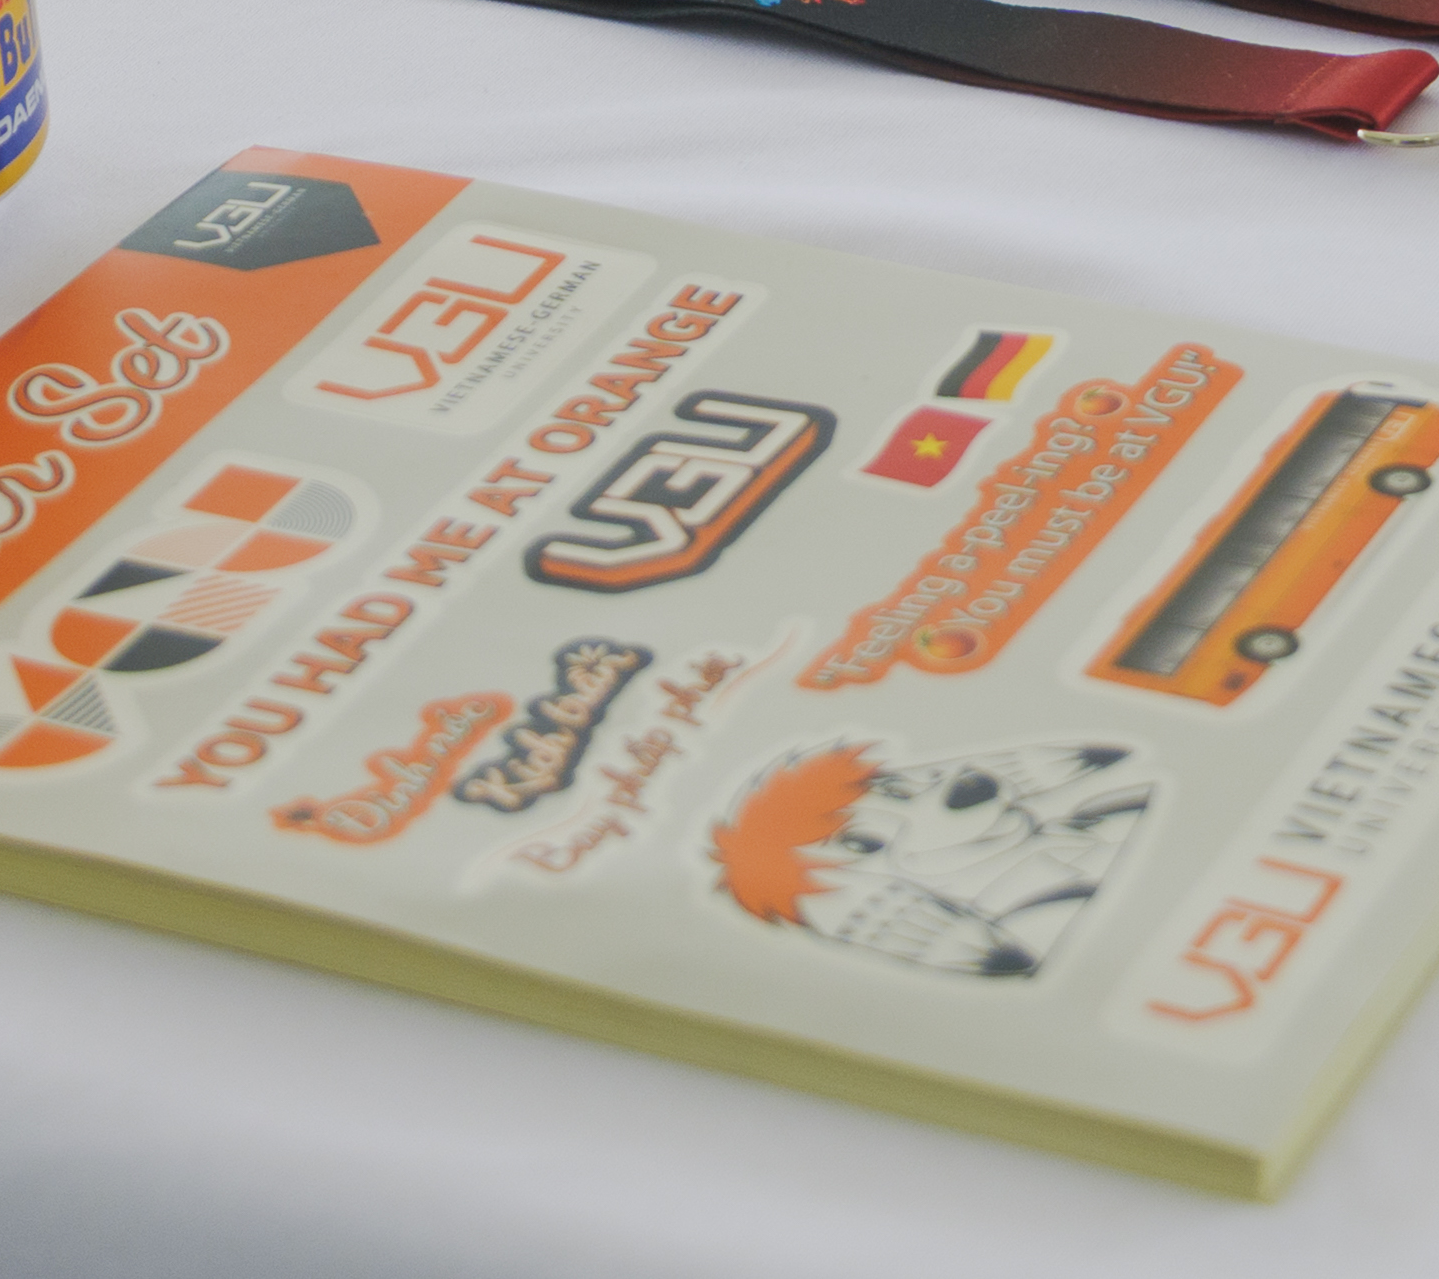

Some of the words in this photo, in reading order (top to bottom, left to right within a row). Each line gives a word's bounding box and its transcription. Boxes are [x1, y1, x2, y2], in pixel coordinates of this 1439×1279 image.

[174, 180, 294, 250] VGU
[9, 307, 230, 445] Set
[315, 233, 568, 402] VGU
[428, 259, 603, 416] VIETNAMESE-GERMAN
[502, 304, 587, 380] UNIVERSITY
[157, 694, 305, 795] YOU
[274, 591, 420, 699] HAD
[384, 516, 498, 590] ME
[467, 458, 557, 520] AT
[526, 281, 745, 456] ORANGE
[939, 578, 1026, 629] You
[1007, 503, 1094, 576] must
[1061, 462, 1128, 503] be
[1109, 428, 1159, 462] at
[1144, 855, 1345, 1022] VGU
